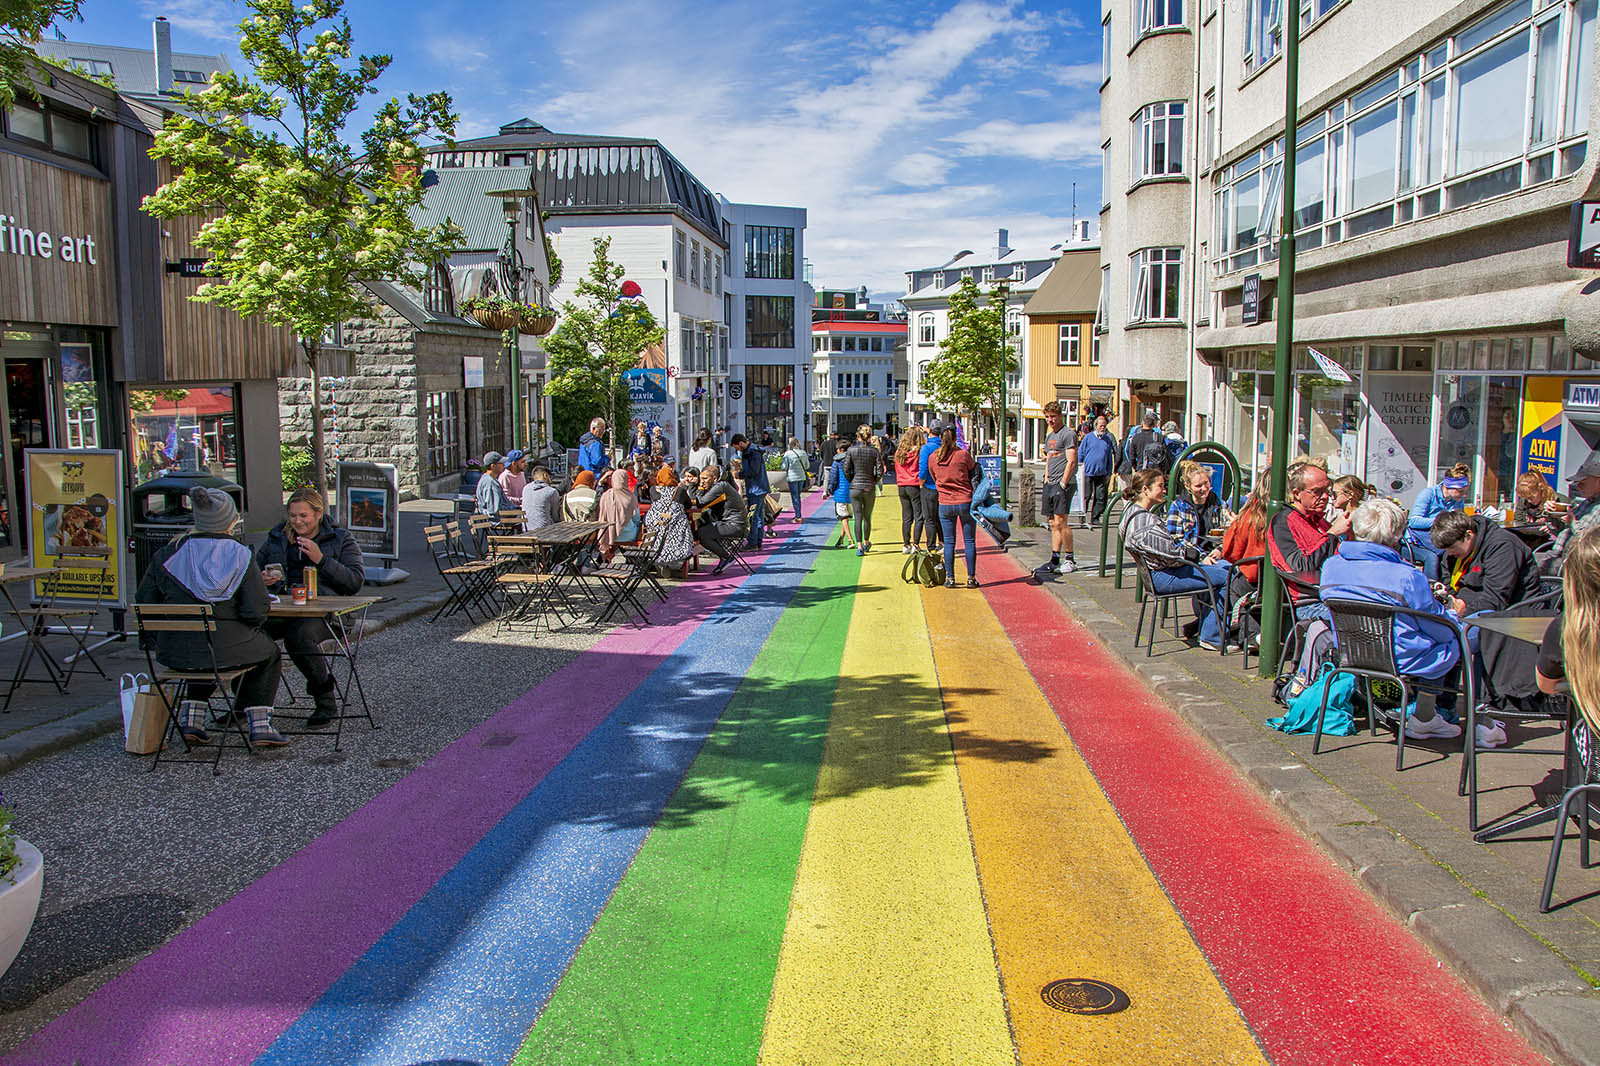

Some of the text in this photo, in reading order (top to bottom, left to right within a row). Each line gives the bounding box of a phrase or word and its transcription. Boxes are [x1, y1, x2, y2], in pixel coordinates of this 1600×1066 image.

[0, 214, 97, 265] fine art
[1381, 391, 1432, 402] TIMELES
[1572, 386, 1600, 406] ATM
[1381, 403, 1423, 414] ARCTIC
[1382, 415, 1430, 425] CRAFTED
[1529, 438, 1557, 459] ATM
[62, 572, 89, 582] AVAILABLE
